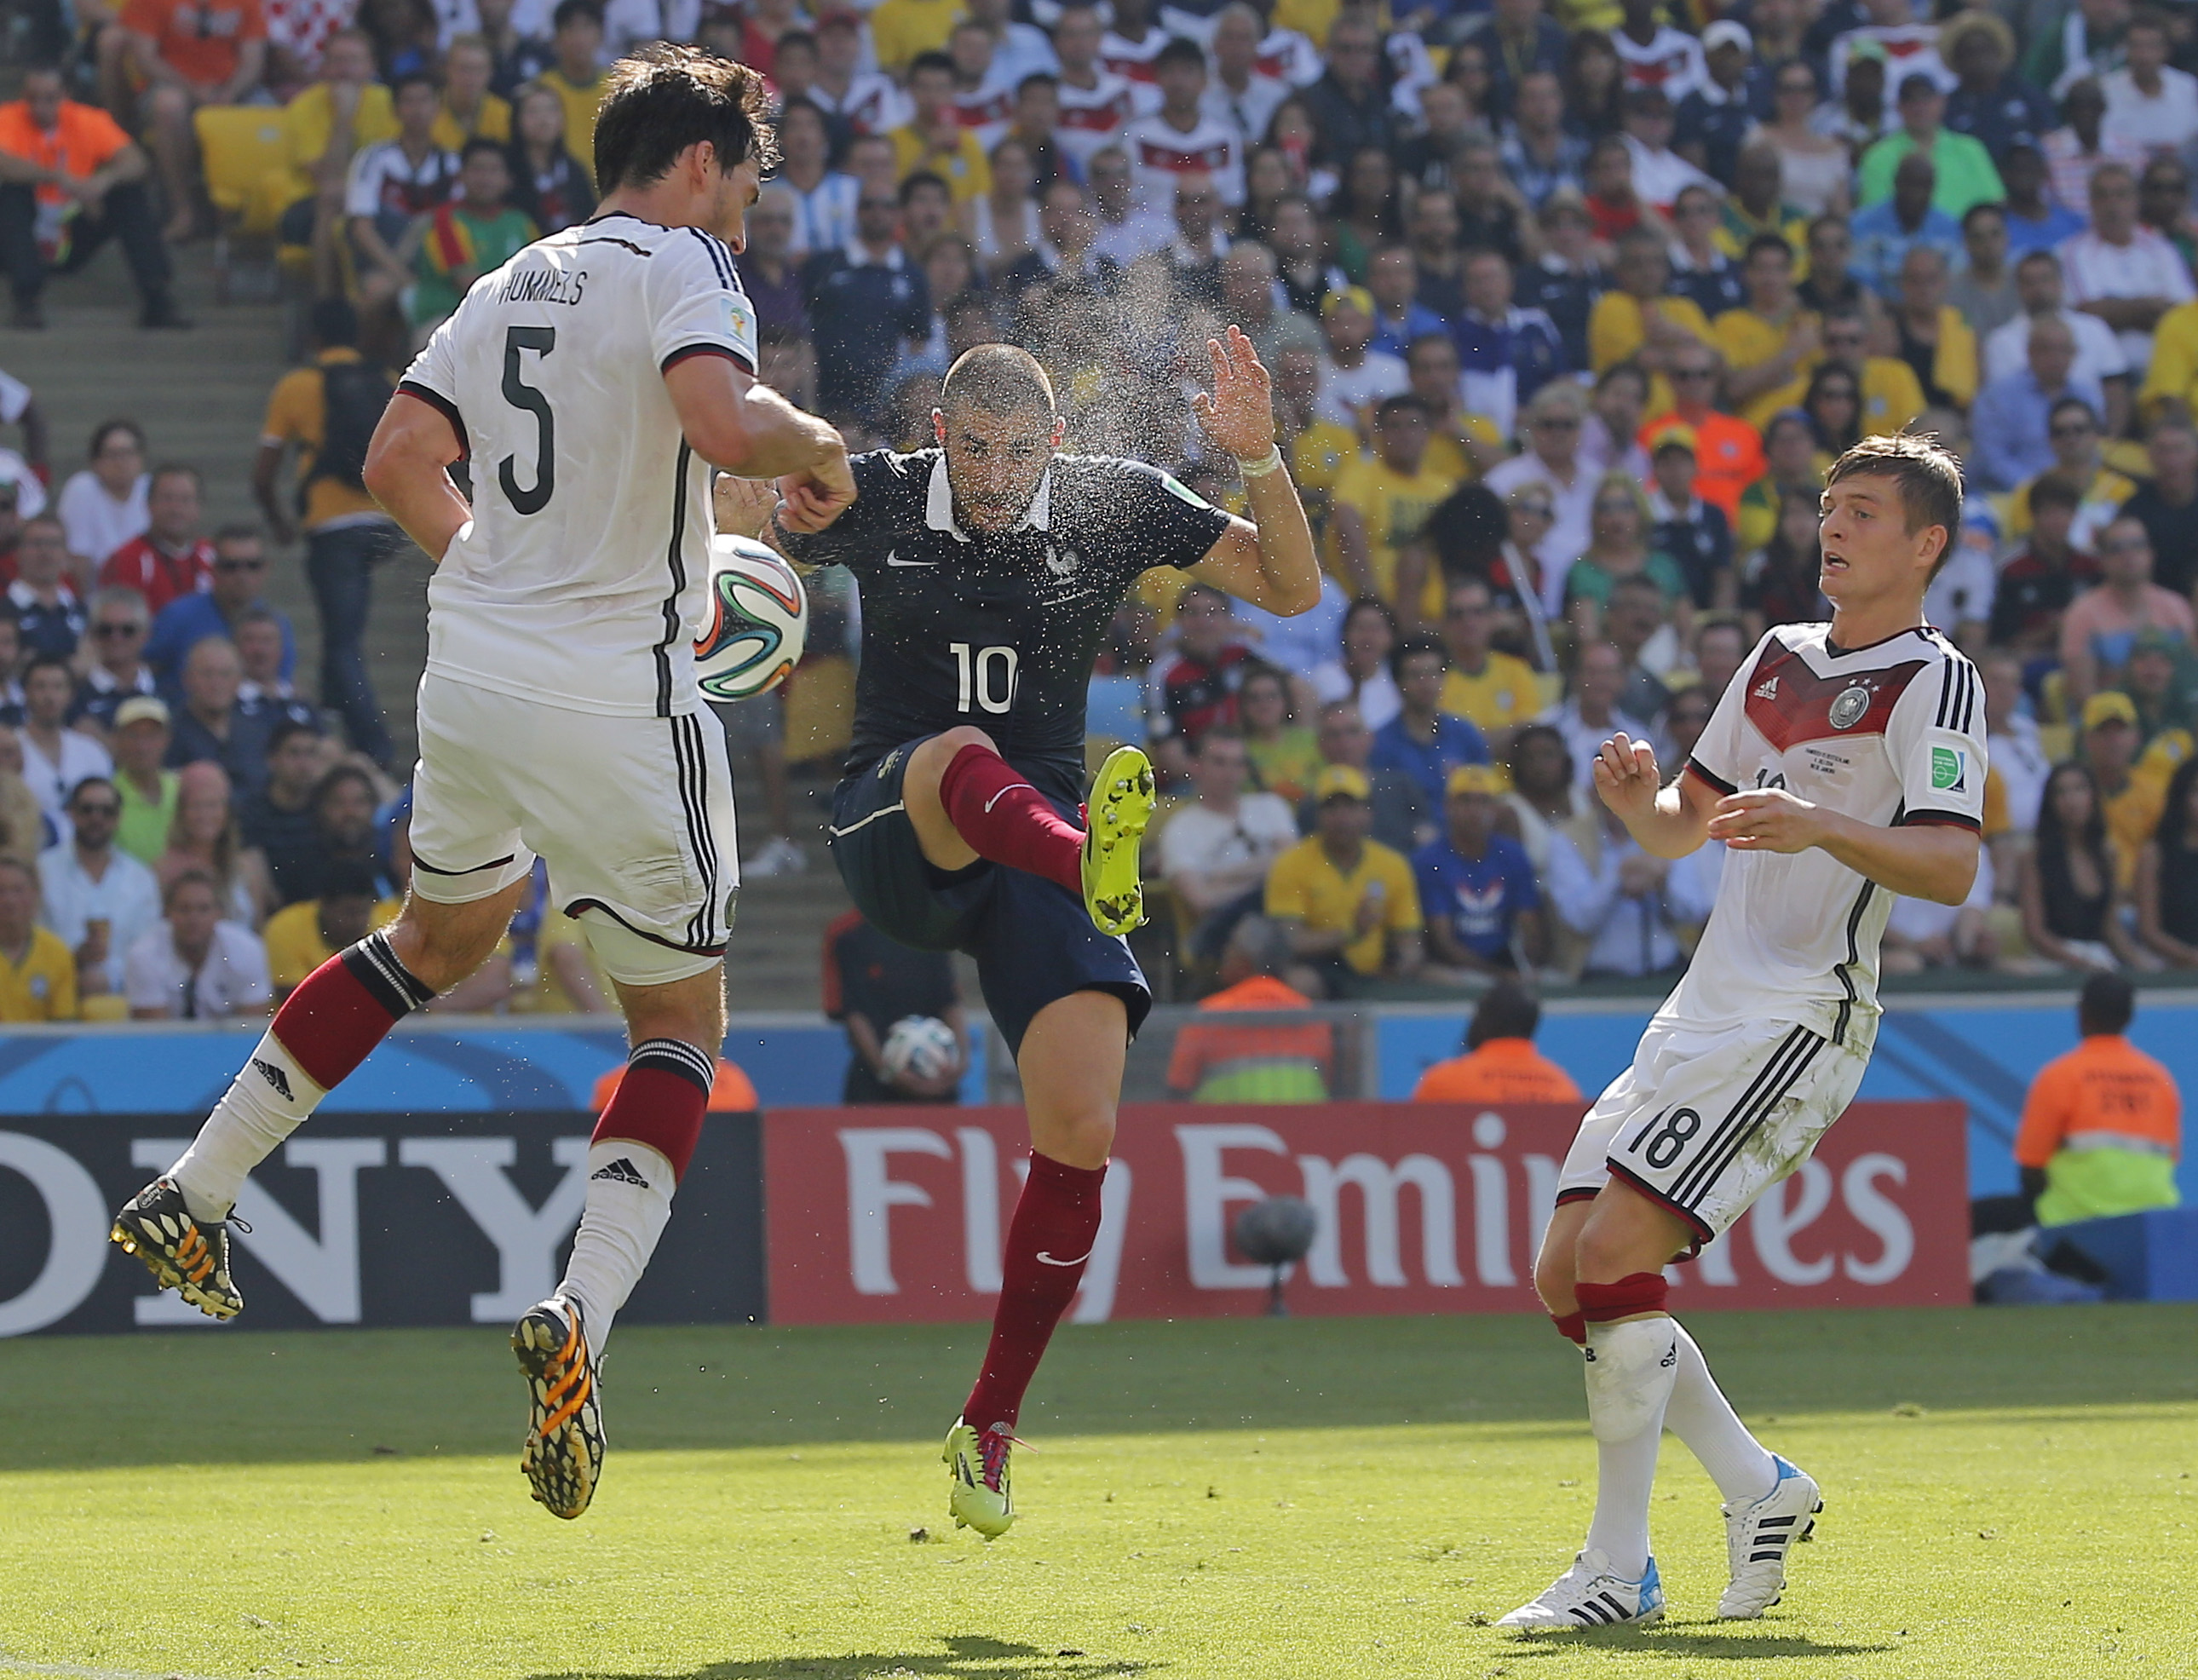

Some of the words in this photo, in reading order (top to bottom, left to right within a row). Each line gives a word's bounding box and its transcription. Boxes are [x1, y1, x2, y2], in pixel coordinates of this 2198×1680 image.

[498, 269, 588, 305] HUMMELS
[499, 326, 555, 515] 5
[950, 642, 1019, 714] 10
[252, 1057, 295, 1102] adidas
[1627, 1100, 1701, 1169] 18
[590, 1167, 649, 1189] adidas
[1174, 1112, 1916, 1288] Emies
